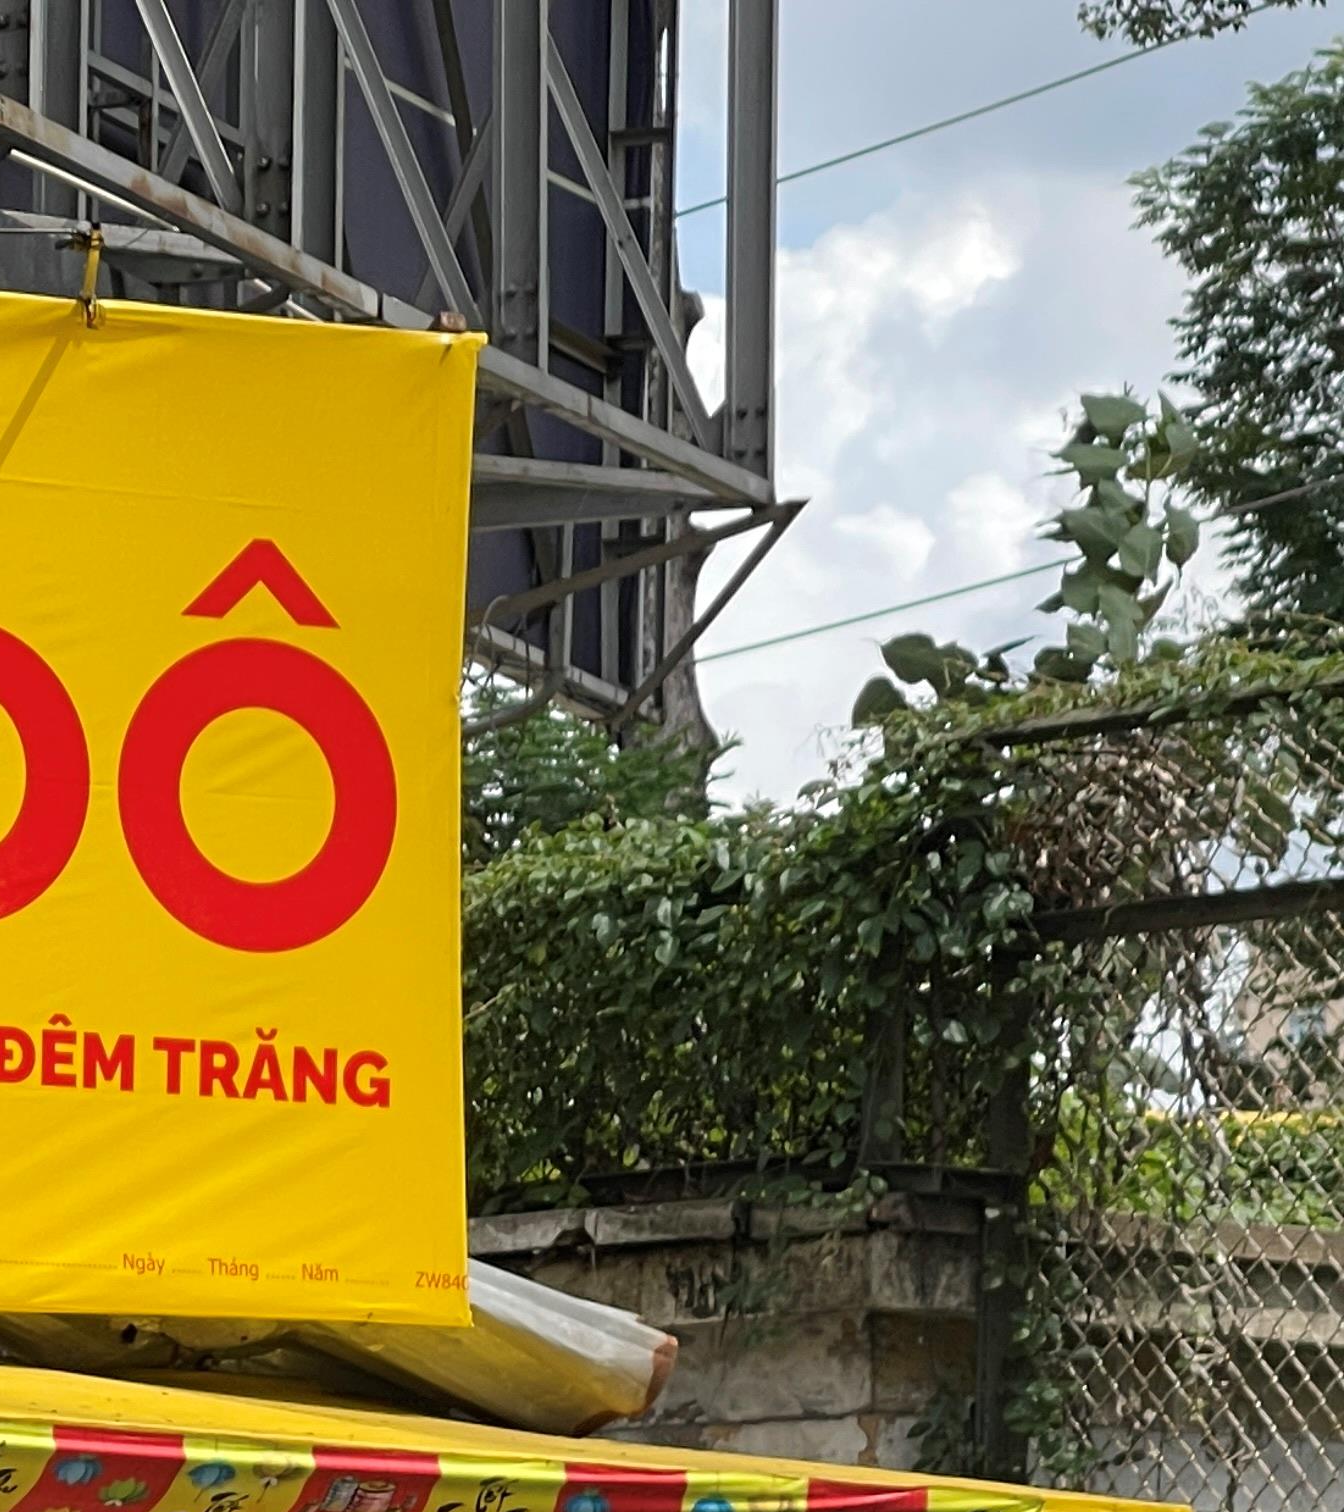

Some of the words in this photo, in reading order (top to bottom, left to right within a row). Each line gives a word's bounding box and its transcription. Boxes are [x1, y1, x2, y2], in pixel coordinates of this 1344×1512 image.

[153, 1027, 391, 1108] TRĂNG
[122, 1252, 166, 1276] Ngày
[207, 1256, 260, 1282] Tháng
[301, 1263, 340, 1284] Năm
